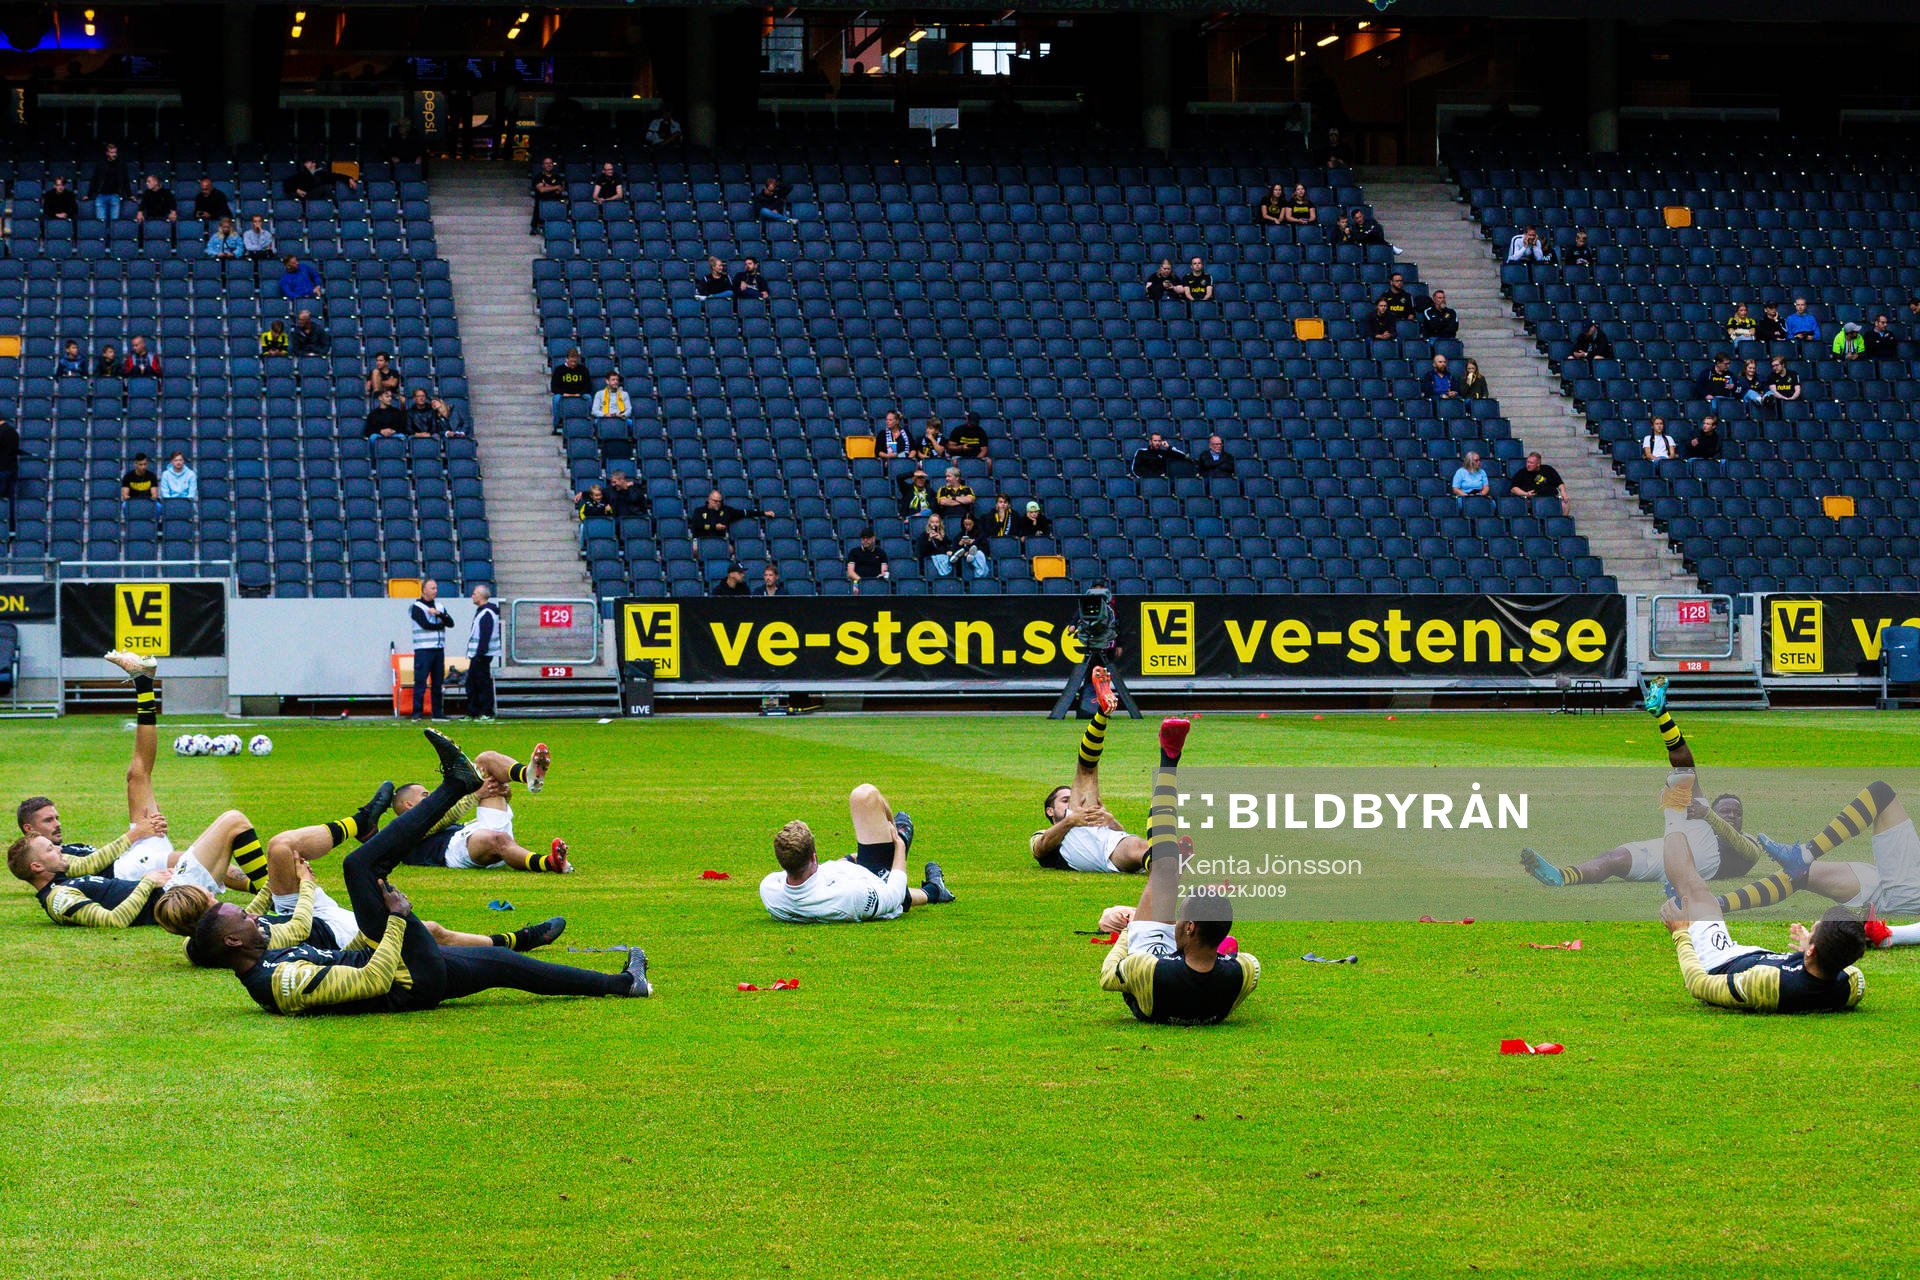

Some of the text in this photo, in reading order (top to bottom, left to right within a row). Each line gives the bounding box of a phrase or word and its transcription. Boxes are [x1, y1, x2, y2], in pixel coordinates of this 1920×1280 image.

[422, 90, 437, 133] pepsi
[123, 591, 162, 626] VE
[1681, 606, 1706, 618] 128
[543, 610, 569, 623] 129
[631, 611, 672, 648] VE
[1147, 608, 1187, 645] VE
[1777, 607, 1816, 643] VE
[124, 636, 161, 648] STEN
[1223, 609, 1607, 663] ve-sten.se
[1851, 617, 1920, 661] v
[634, 658, 672, 669] EN
[1150, 655, 1187, 667] STEN
[1780, 653, 1816, 665] STEN
[1687, 662, 1702, 670] 128
[547, 668, 566, 677] 129
[631, 705, 650, 714] LIVE
